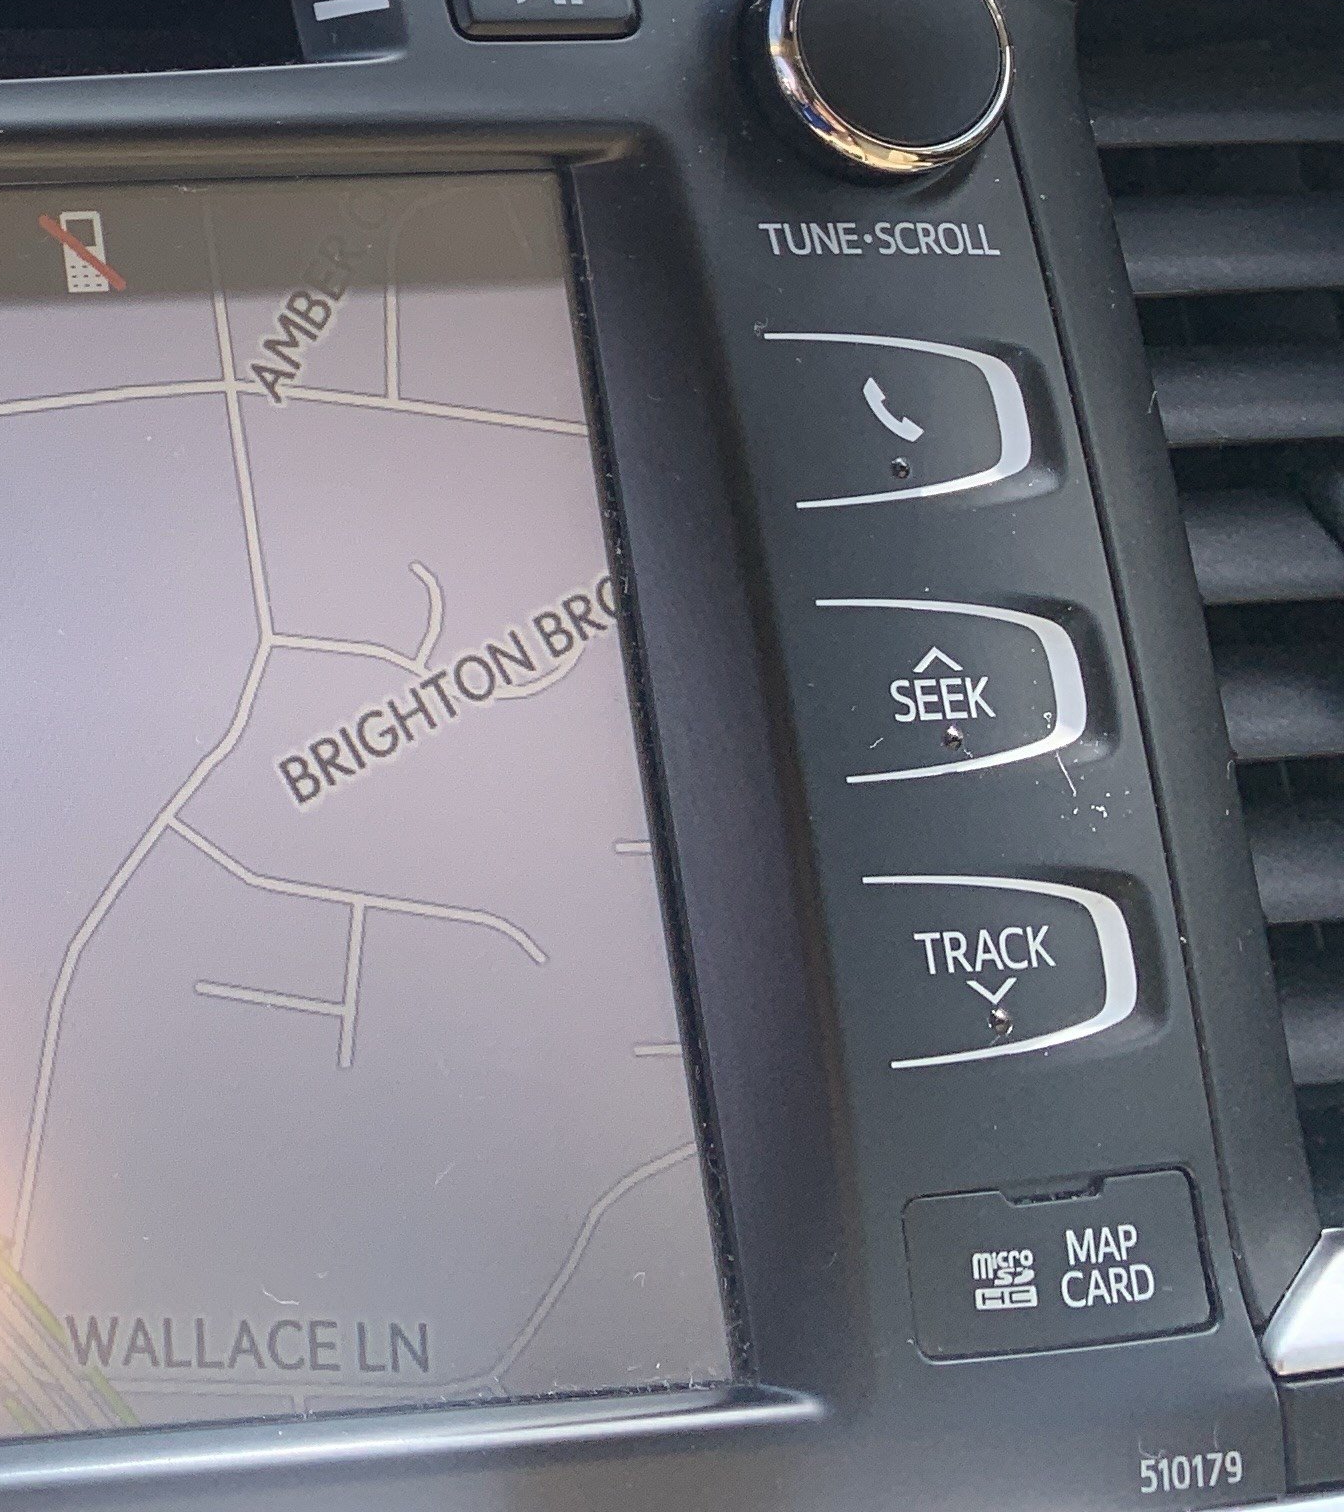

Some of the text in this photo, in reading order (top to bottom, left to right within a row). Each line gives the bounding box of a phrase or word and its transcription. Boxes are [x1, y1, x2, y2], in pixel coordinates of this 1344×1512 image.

[278, 630, 536, 804] BRIGHTON
[889, 676, 996, 722] SEEK
[915, 925, 1056, 975] TRACK
[1066, 1224, 1138, 1265] MAP
[1061, 1263, 1155, 1308] CARD
[65, 1315, 431, 1373] WALLACE LN
[1139, 1450, 1244, 1494] 510179
